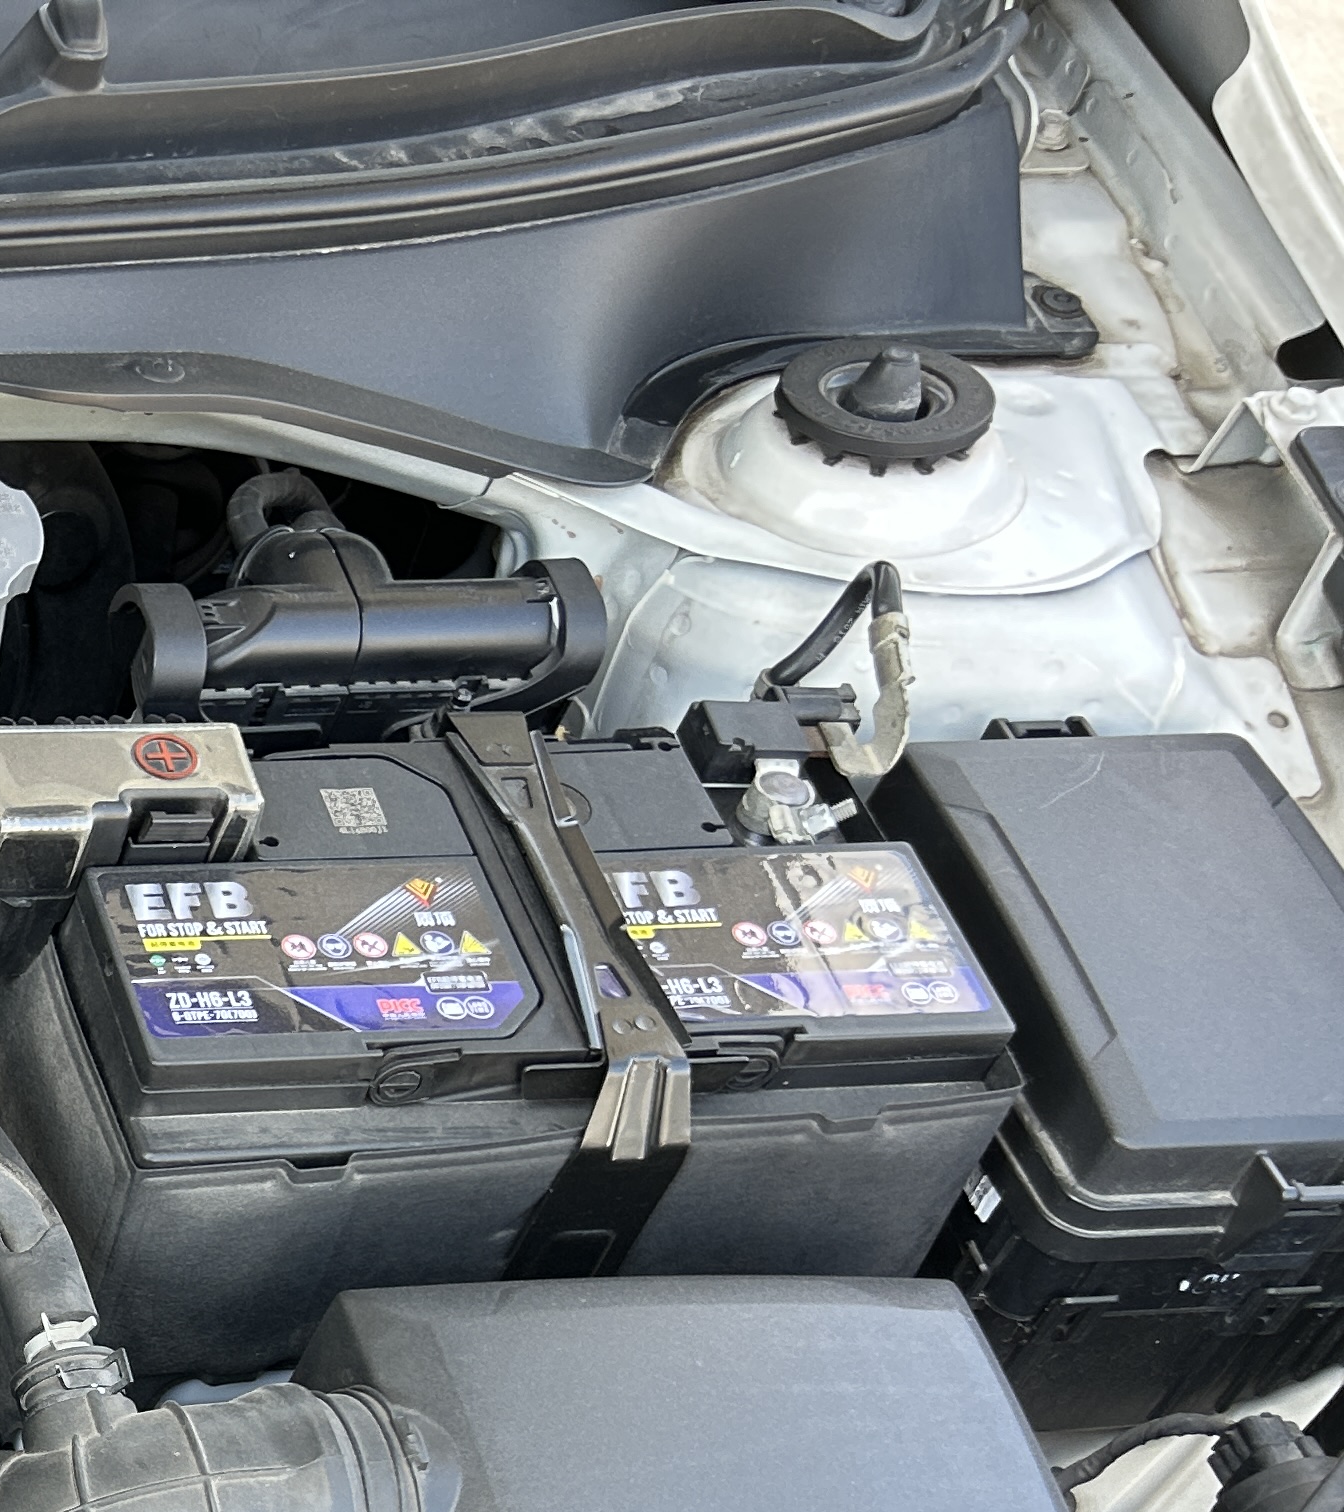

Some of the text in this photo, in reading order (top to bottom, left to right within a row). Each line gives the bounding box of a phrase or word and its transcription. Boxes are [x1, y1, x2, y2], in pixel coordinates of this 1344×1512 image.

[612, 870, 702, 908] FB
[125, 881, 254, 921] EFB
[658, 909, 674, 924] &
[675, 908, 717, 922] START
[138, 920, 268, 938] FOR STOP & START
[165, 990, 253, 1010] ZD-H6-L3
